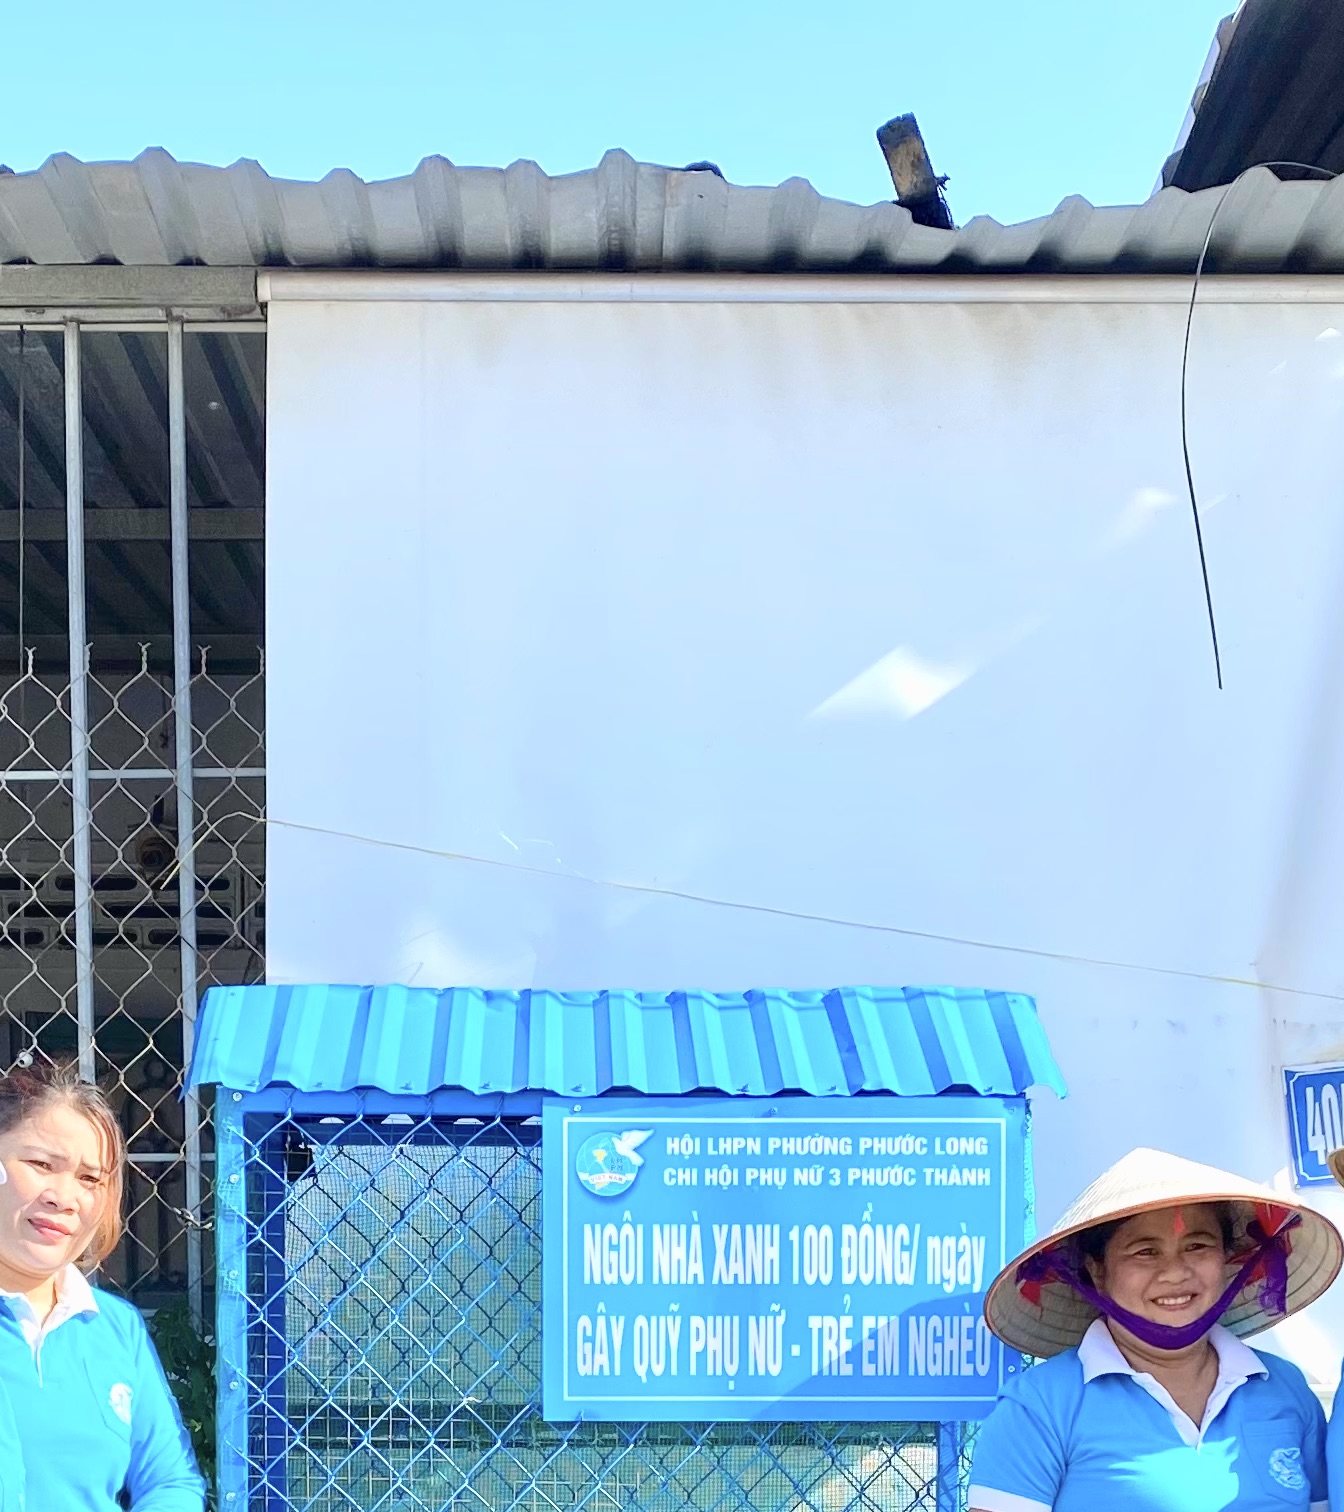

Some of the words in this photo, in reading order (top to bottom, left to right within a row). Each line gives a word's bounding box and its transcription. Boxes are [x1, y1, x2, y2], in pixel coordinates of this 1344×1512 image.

[666, 1132, 701, 1160] HỘI
[707, 1136, 761, 1156] LHPN
[768, 1132, 853, 1156] PHƯỜNG
[859, 1132, 928, 1156] PHƯỚC
[934, 1136, 988, 1156] LONG
[663, 1166, 697, 1187] CHI
[704, 1163, 739, 1190] HỘI
[745, 1167, 787, 1190] PHỤ
[793, 1163, 825, 1187] NỮ
[828, 1166, 842, 1187] 3
[847, 1163, 917, 1187] PHƯỚC
[923, 1163, 991, 1187] THÀNH
[583, 1209, 644, 1286] NGÔI
[652, 1210, 705, 1286] NHÀ
[711, 1223, 781, 1286] XANH
[788, 1223, 834, 1287] 100
[926, 1211, 987, 1294] ngày
[576, 1301, 626, 1377] GÂY
[633, 1302, 682, 1384] QUỸ
[689, 1315, 740, 1391] PHỤ
[748, 1302, 787, 1377] NỮ
[808, 1293, 854, 1377] TRẺ
[862, 1315, 900, 1377] EM
[908, 1301, 991, 1378] NGHÈO
